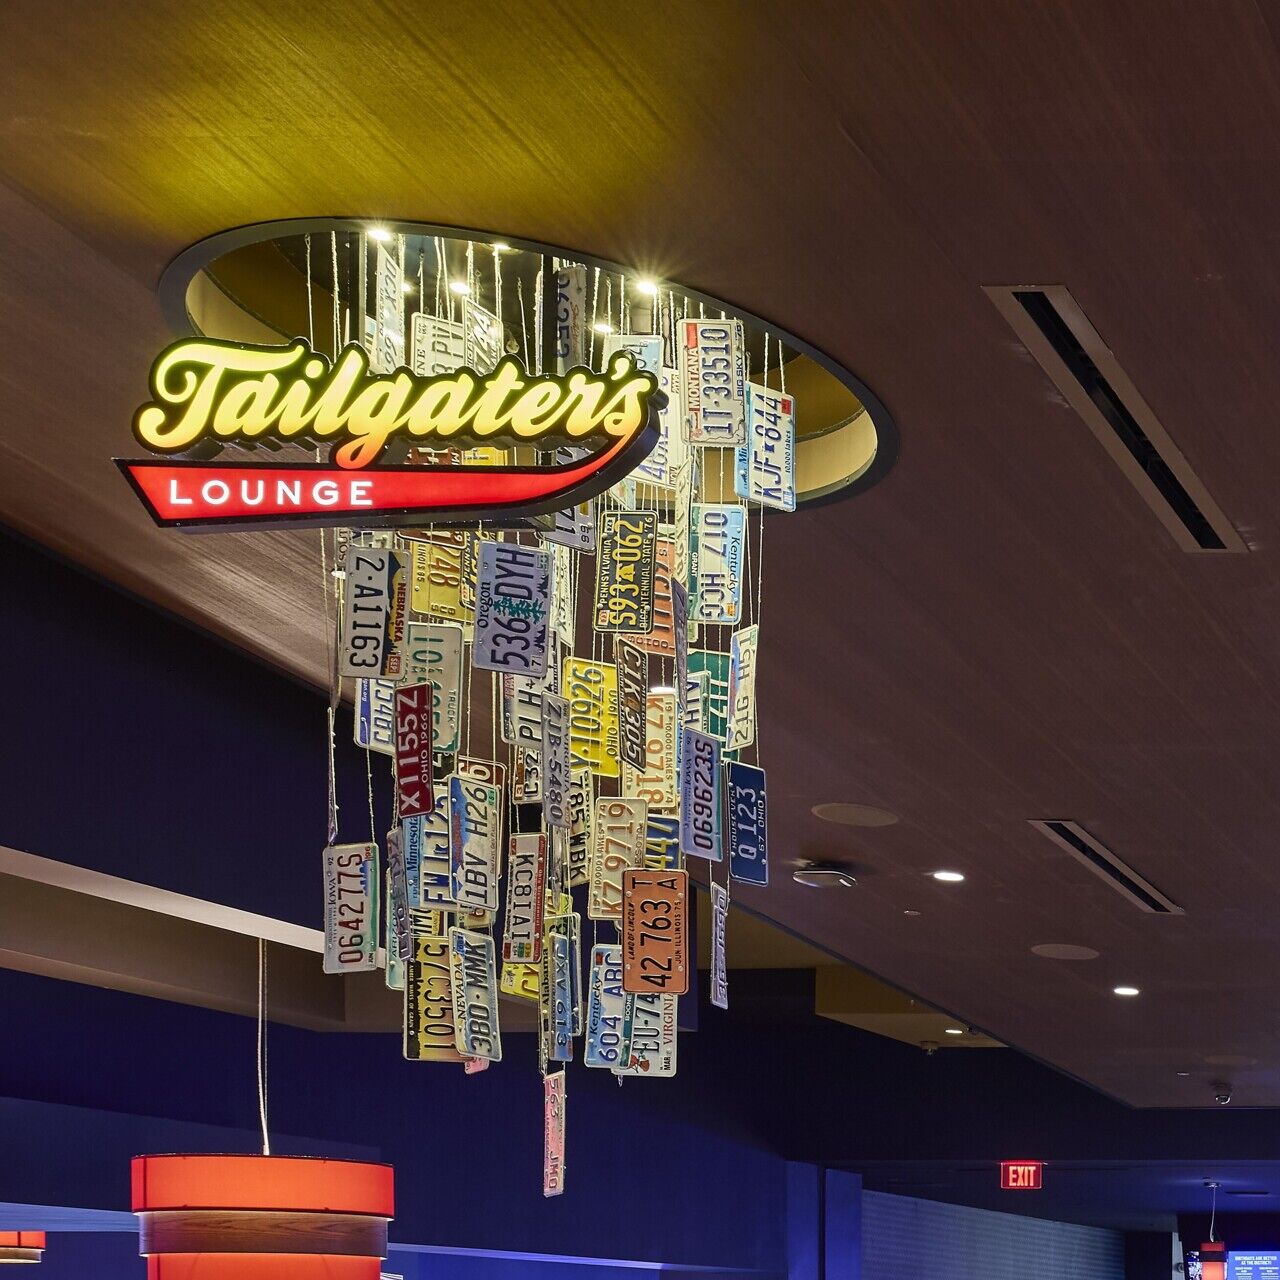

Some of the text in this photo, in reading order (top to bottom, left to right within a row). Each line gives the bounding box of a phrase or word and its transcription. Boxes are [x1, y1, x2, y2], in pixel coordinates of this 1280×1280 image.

[139, 342, 650, 468] Tailgater's
[688, 348, 699, 408] MONTANA
[755, 393, 781, 437] 844
[169, 480, 374, 506] LOUNGE
[600, 539, 613, 604] PENNSYLVANIA
[609, 520, 643, 625] S93 062
[701, 512, 727, 618] 017 HCG
[727, 537, 741, 594] Kentucky
[393, 583, 407, 642] NEBRASKA
[477, 581, 491, 629] Oregon
[490, 548, 535, 669] 536 DYH
[447, 690, 457, 722] TRUCK
[624, 706, 642, 760] 305
[398, 690, 420, 810] X1155Z
[419, 712, 429, 784] OHIO 1966
[606, 726, 617, 757] OHIO
[464, 787, 488, 837] H26
[736, 787, 757, 836] 123
[757, 800, 765, 828] OHIO
[328, 877, 336, 906] IOWA
[337, 853, 364, 963] 064277S
[627, 902, 635, 932] LINCOLN
[640, 900, 673, 988] 42 763
[454, 961, 466, 1020] NEVADA
[541, 948, 550, 1006] Alabama
[588, 975, 603, 1035] Kentucky
[598, 1015, 621, 1063] 604
[1008, 1165, 1036, 1188] EXIT
